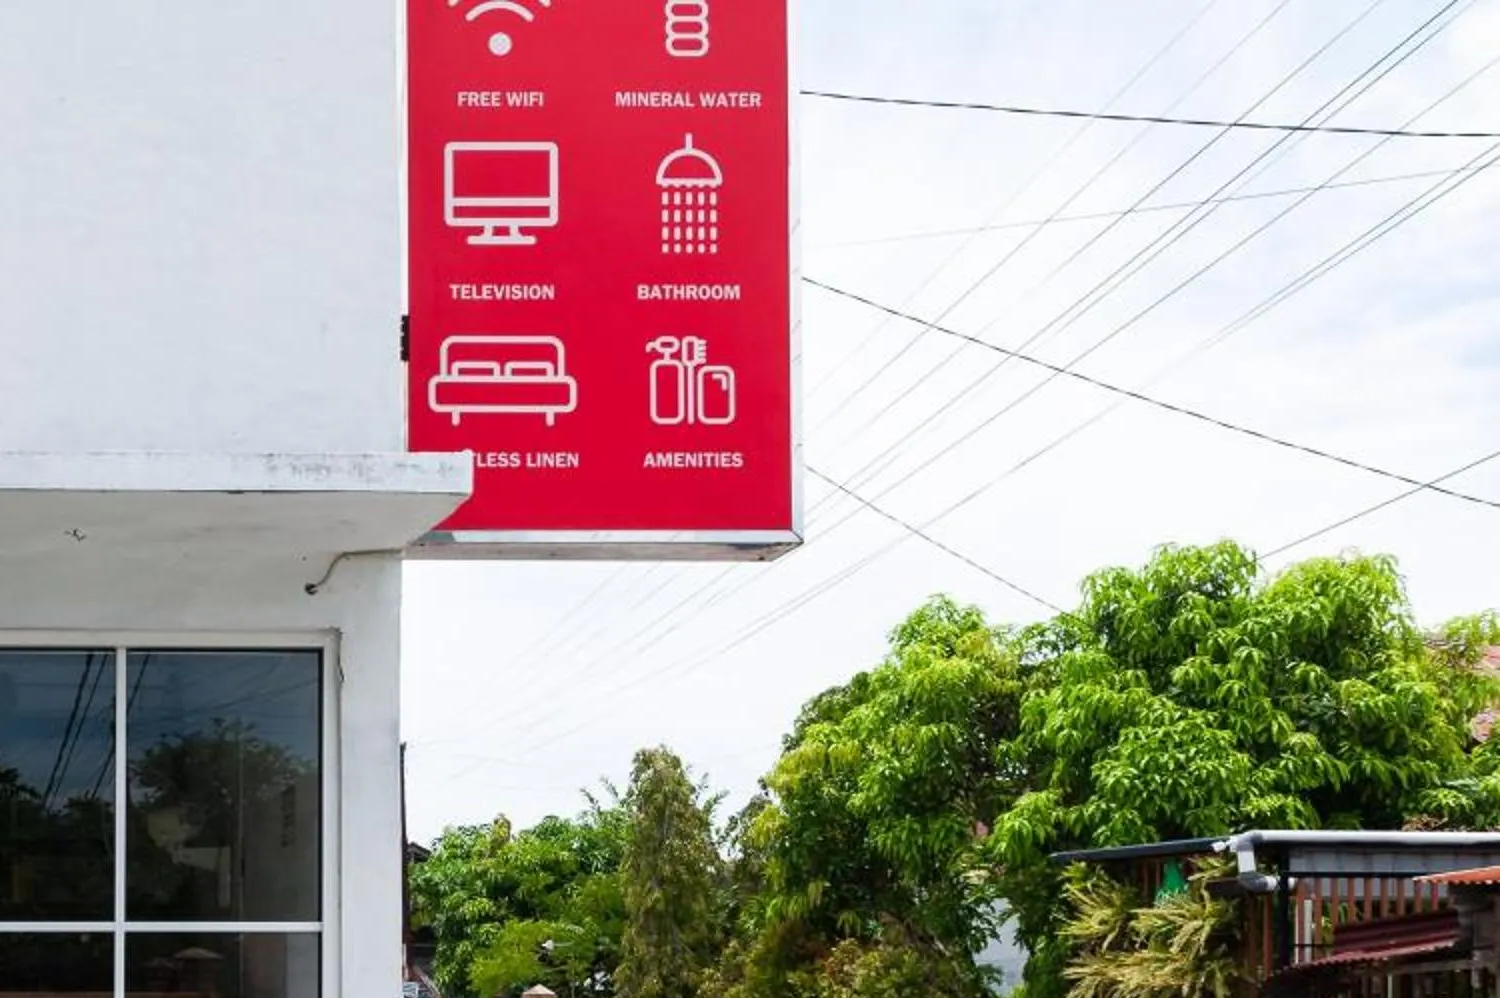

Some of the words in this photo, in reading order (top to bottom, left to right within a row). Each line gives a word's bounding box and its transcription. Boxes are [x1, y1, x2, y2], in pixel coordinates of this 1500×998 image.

[457, 91, 501, 107] FREE
[506, 91, 544, 107] WIFI
[615, 91, 695, 107] MINERAL
[700, 91, 761, 108] WATER
[449, 284, 555, 300] TELEVISION
[637, 284, 741, 300] BATHROOM
[472, 452, 521, 467] LESS
[526, 452, 580, 468] LINEN
[643, 451, 744, 468] AMENITIES
